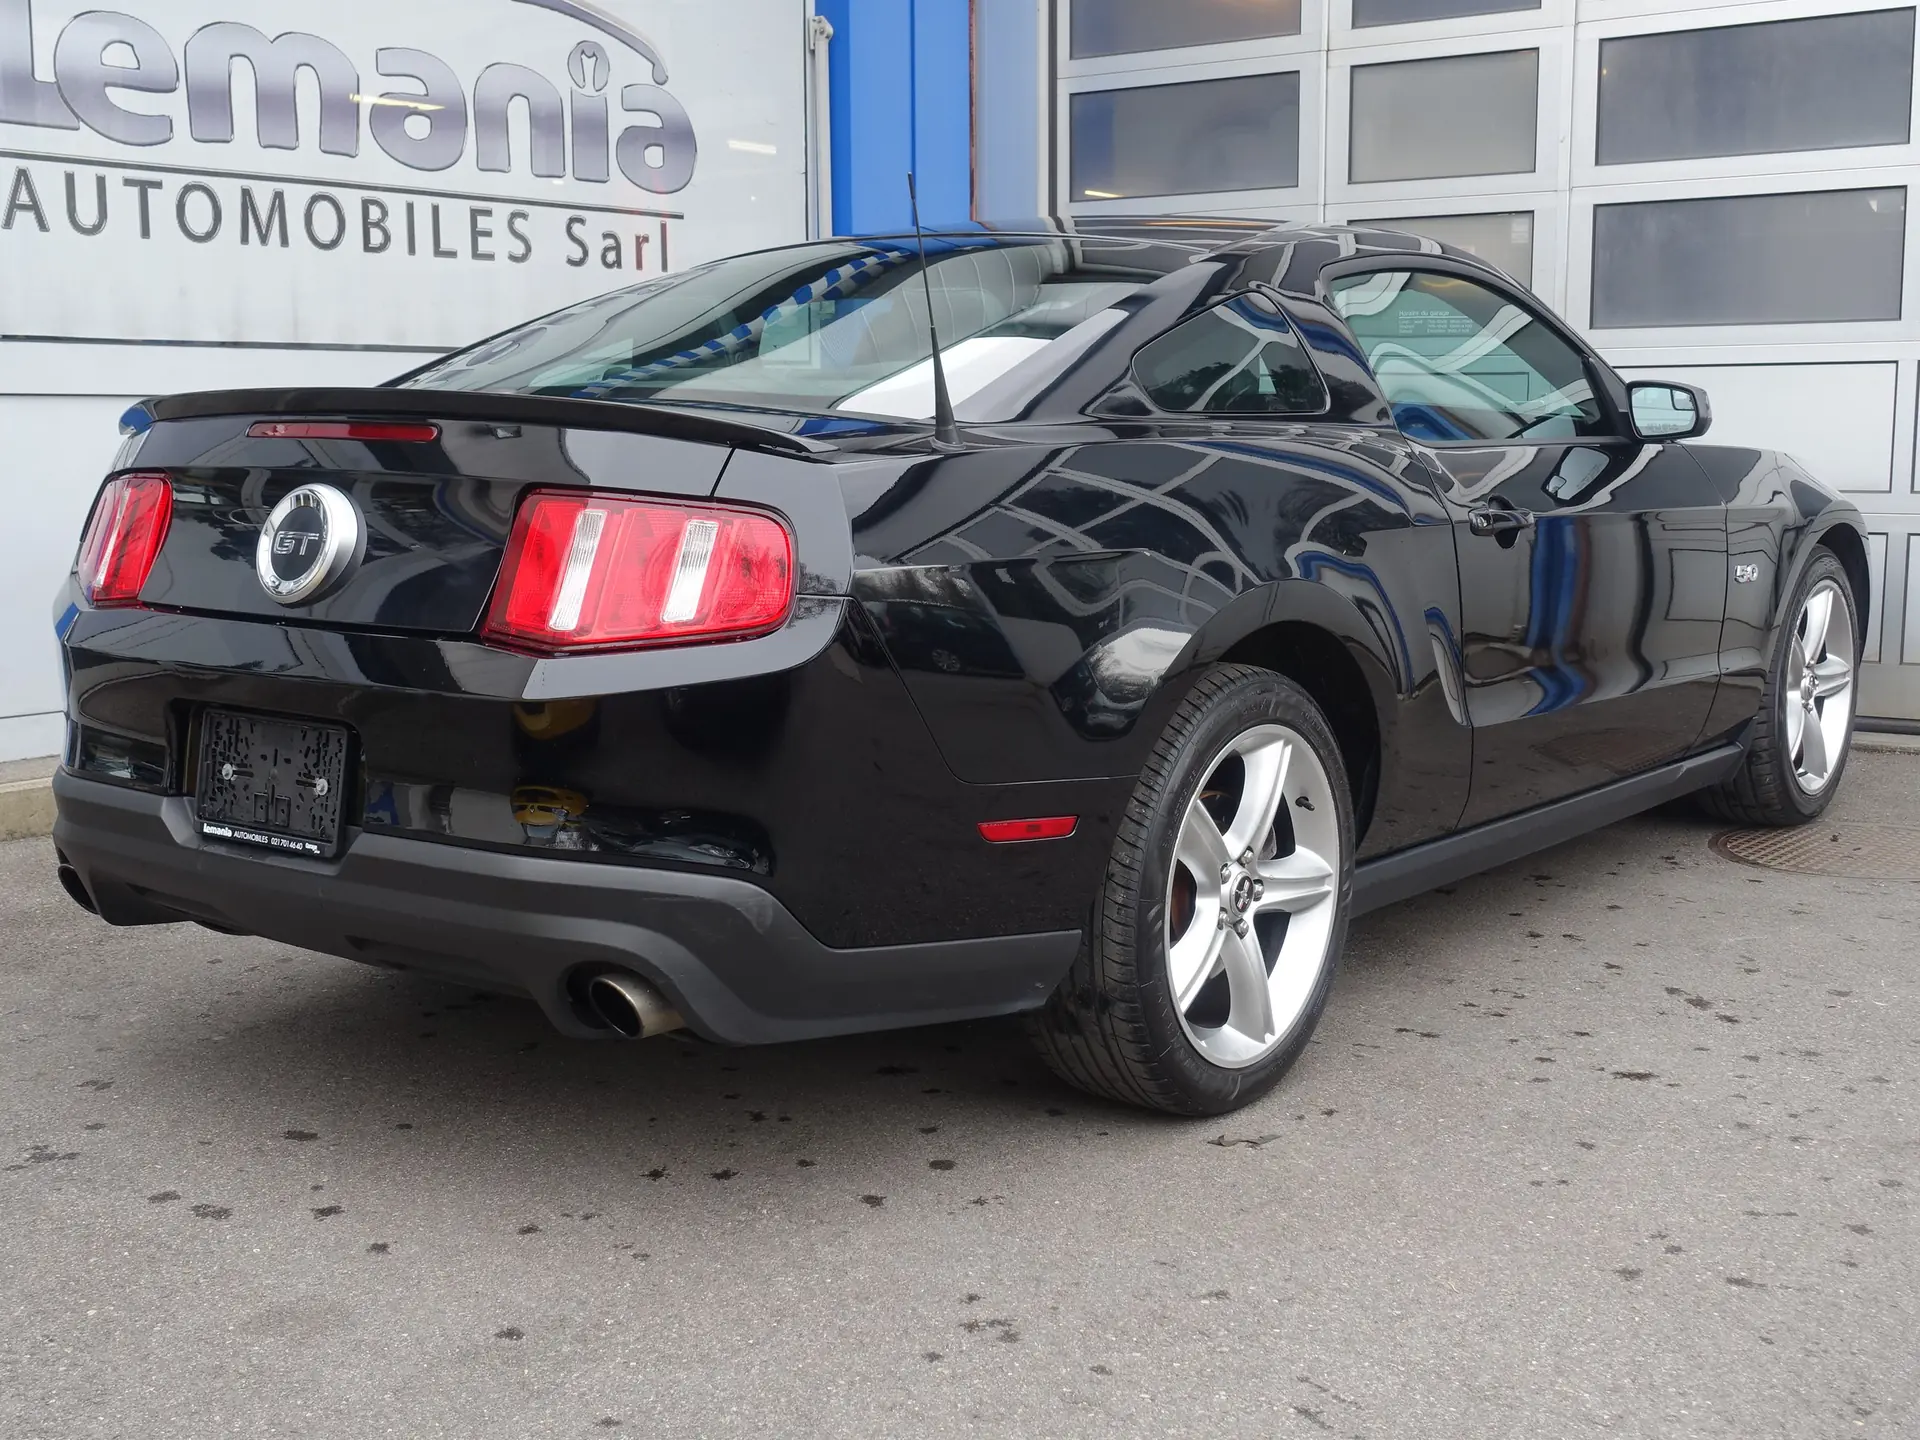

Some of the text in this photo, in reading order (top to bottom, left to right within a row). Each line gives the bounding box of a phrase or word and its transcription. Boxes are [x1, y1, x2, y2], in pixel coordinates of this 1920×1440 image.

[2, 165, 669, 273] AUTOMOBILES Sarl
[273, 530, 320, 556] GT
[234, 831, 268, 843] AUTOMOBILES
